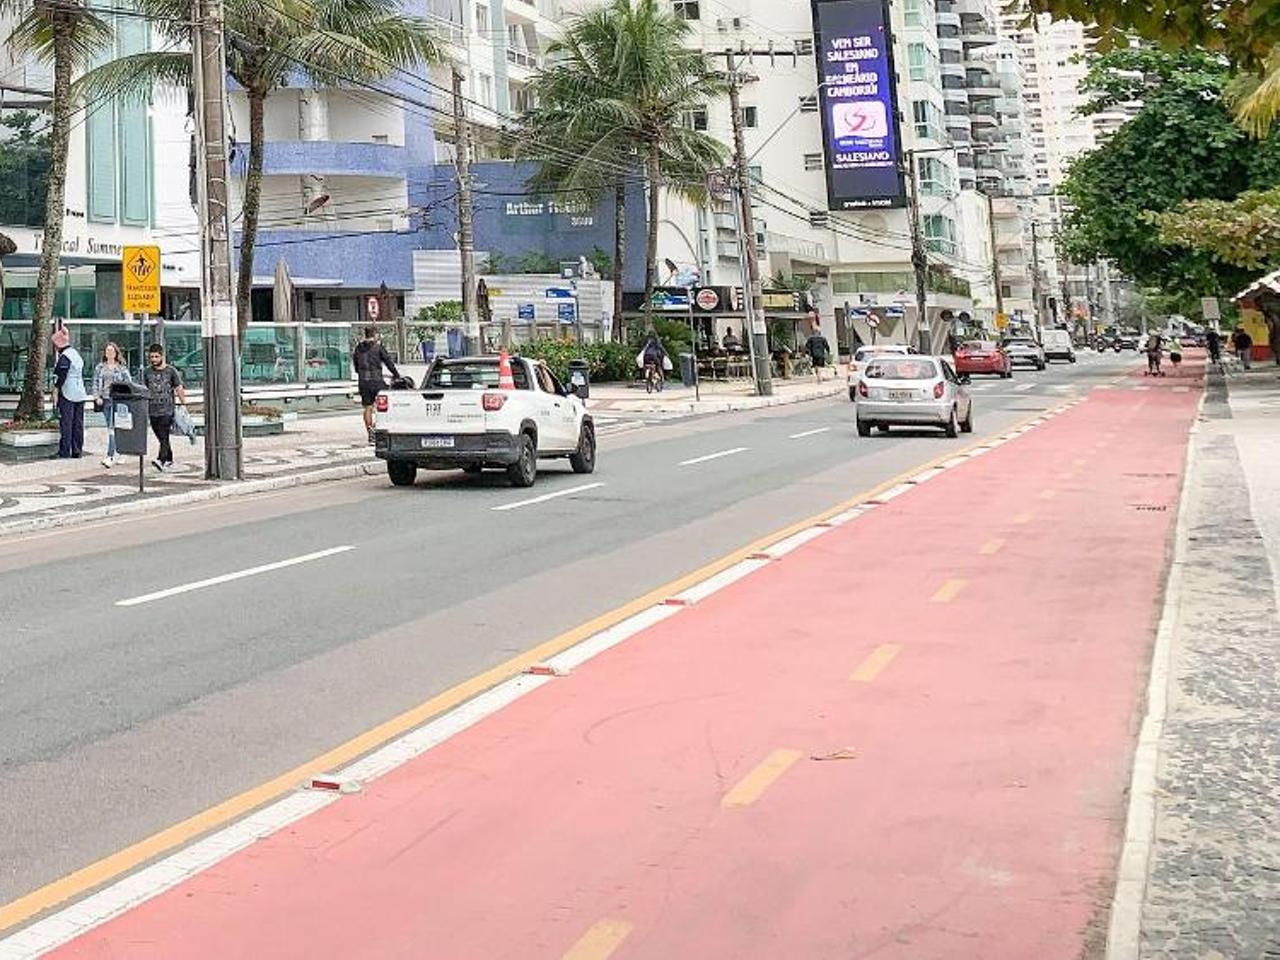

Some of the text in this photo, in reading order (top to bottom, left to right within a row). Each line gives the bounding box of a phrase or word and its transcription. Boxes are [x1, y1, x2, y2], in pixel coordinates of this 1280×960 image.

[831, 36, 872, 49] VEM SER
[826, 47, 879, 62] SALESIANO
[835, 151, 890, 162] SALESIANO
